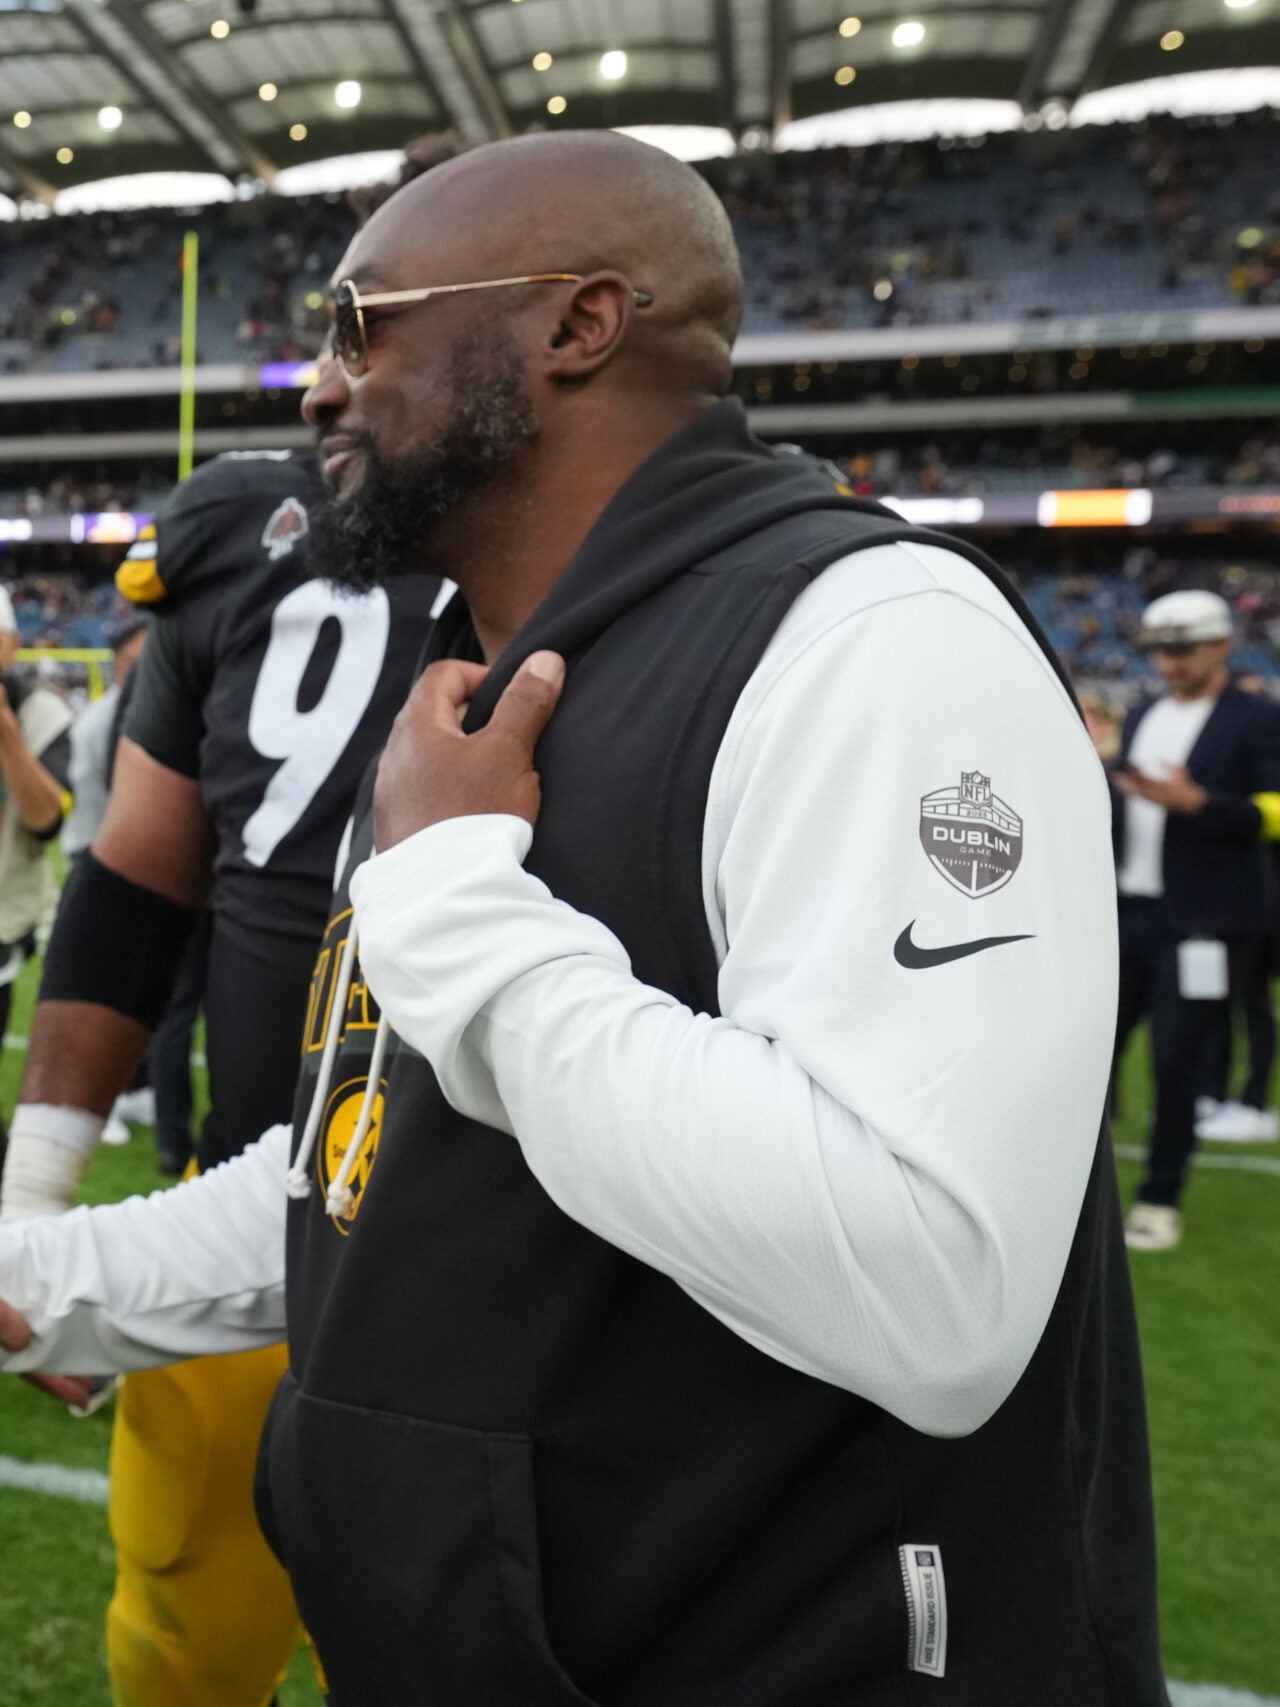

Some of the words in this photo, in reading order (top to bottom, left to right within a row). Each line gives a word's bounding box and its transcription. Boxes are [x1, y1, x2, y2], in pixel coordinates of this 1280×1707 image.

[242, 577, 458, 867] 9
[962, 783, 991, 803] NFL
[932, 826, 1011, 856] DUBLIN
[959, 846, 992, 857] GAME
[922, 1571, 935, 1599] ISSUE
[925, 1601, 936, 1645] STANDARD
